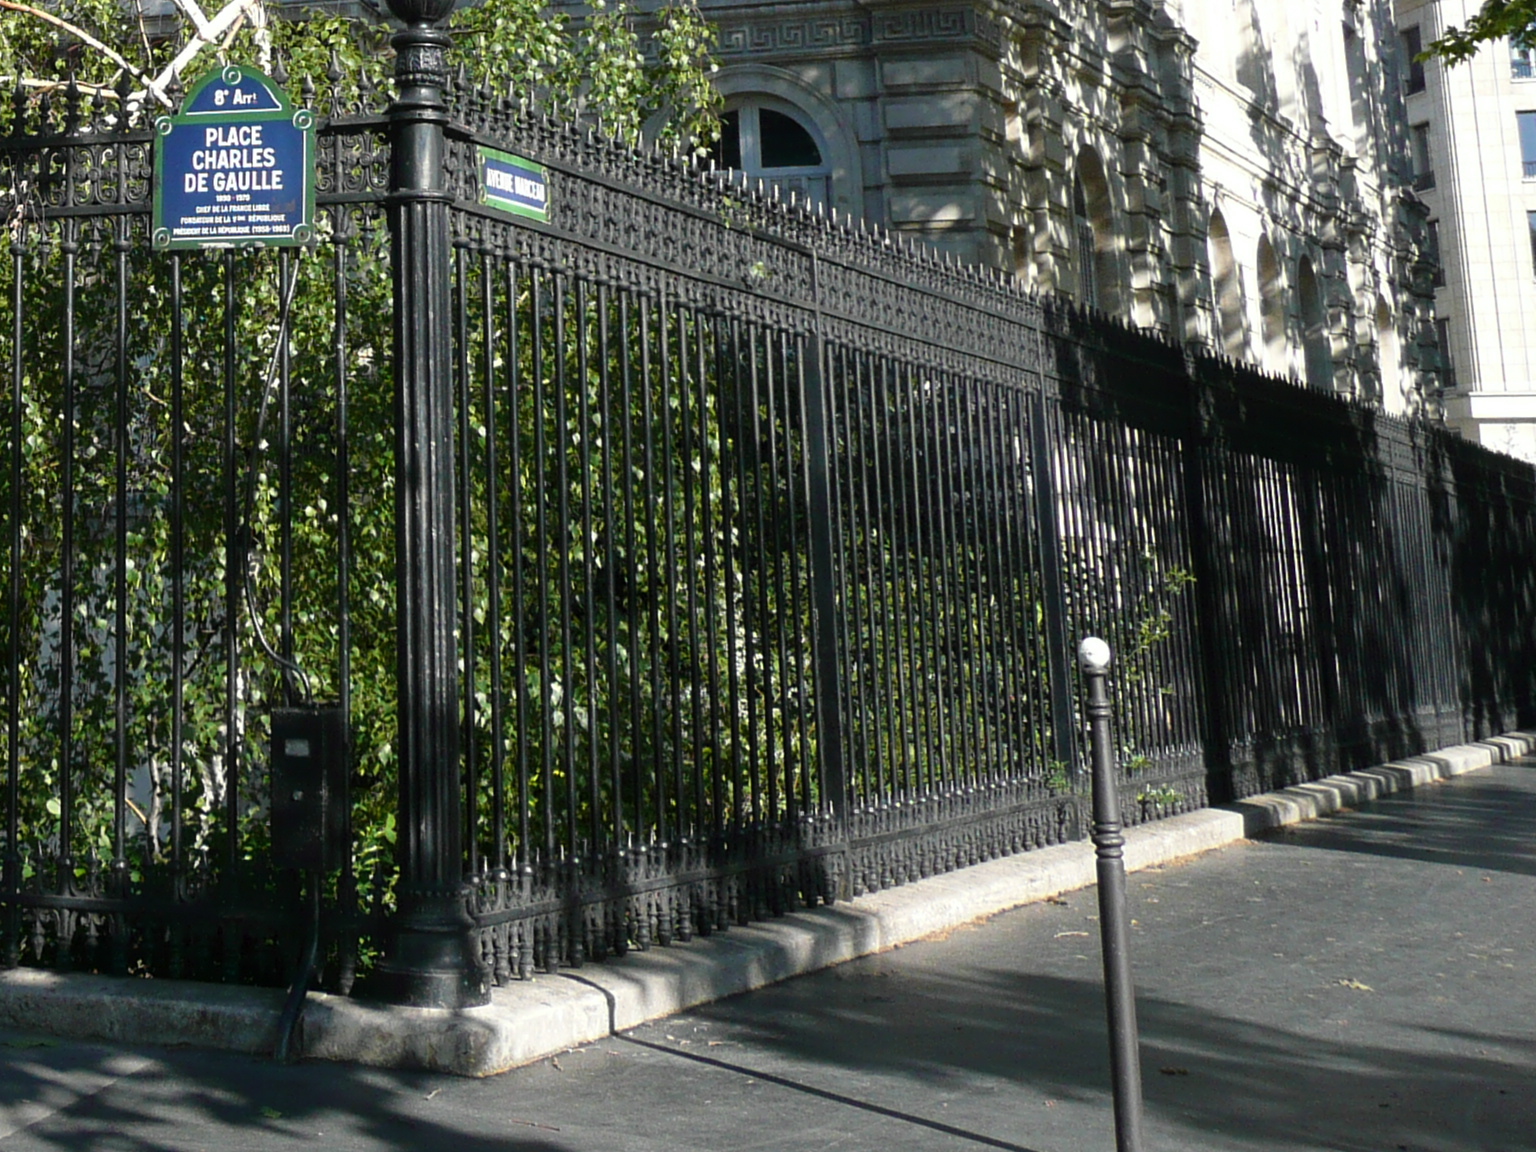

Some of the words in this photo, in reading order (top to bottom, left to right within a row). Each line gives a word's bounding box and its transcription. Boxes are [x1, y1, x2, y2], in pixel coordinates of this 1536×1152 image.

[205, 125, 262, 147] PLACE
[192, 148, 275, 170] CHARLES
[184, 173, 208, 193] DE
[213, 170, 283, 191] GAULLE
[487, 167, 514, 193] AVENUE
[514, 175, 545, 202] MARCEAU
[196, 205, 211, 214] CHEF
[212, 205, 220, 213] DE
[221, 205, 229, 213] LA
[229, 204, 252, 212] FRANCE
[252, 203, 270, 212] LIBRE
[180, 216, 214, 225] FONDATEUR
[214, 216, 222, 224] DE
[223, 215, 231, 223] LA
[201, 226, 209, 235] DE
[209, 226, 217, 234] LA
